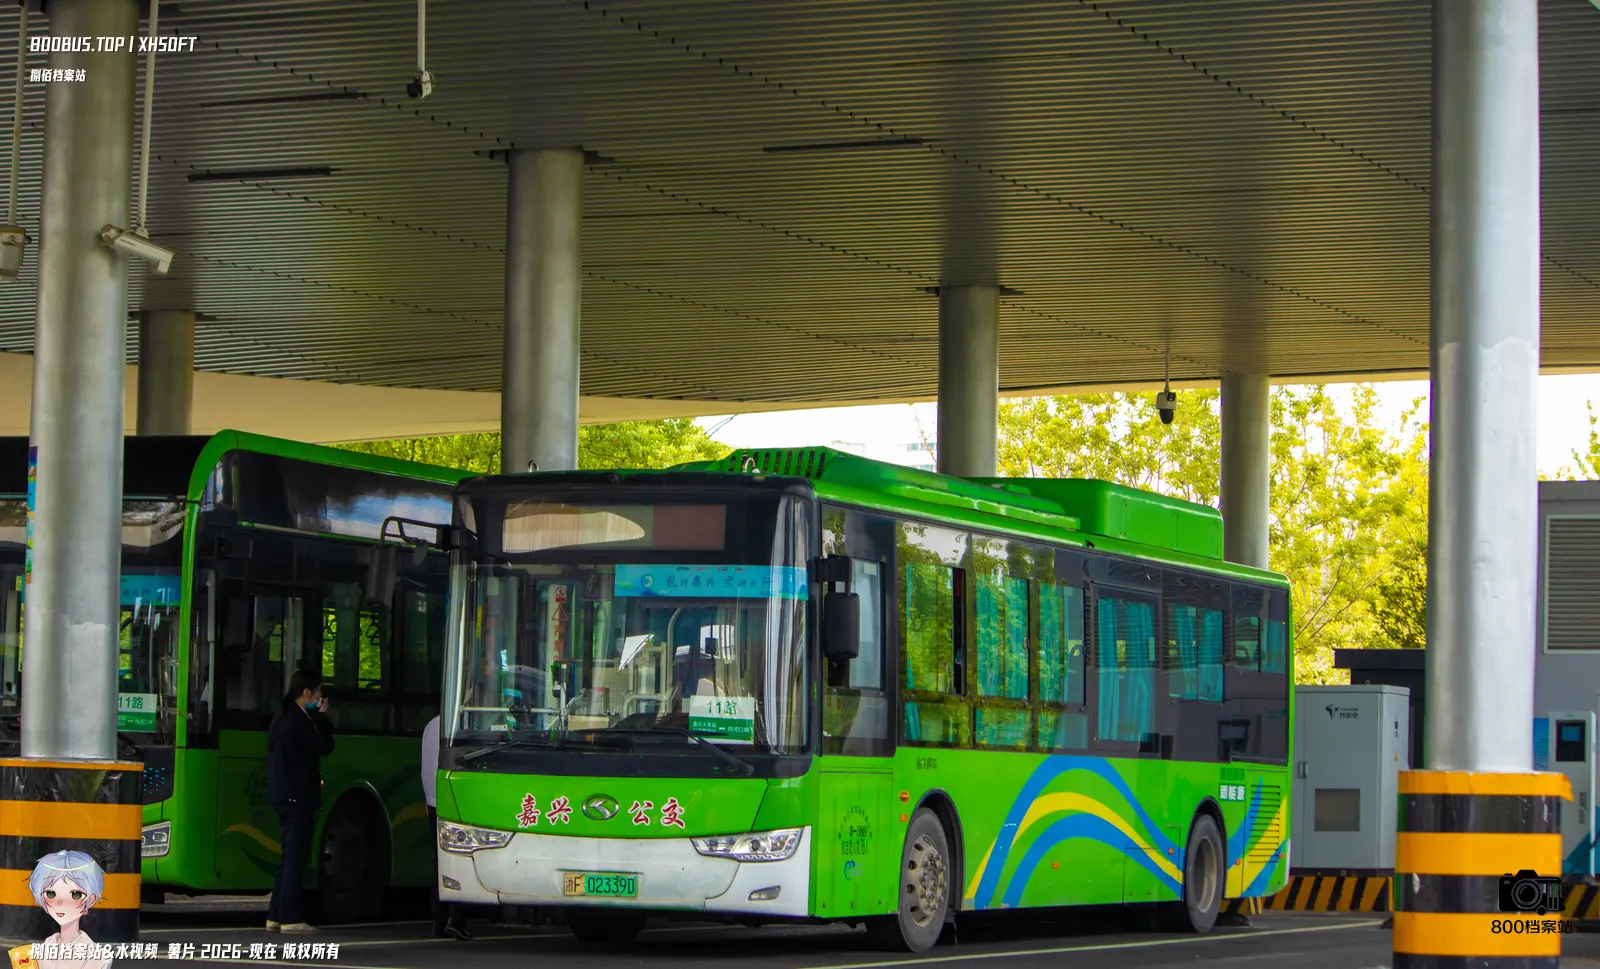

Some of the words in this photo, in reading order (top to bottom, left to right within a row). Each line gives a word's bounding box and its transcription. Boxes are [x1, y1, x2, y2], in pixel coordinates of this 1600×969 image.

[707, 700, 737, 715] 11路
[516, 793, 573, 828] 嘉兴
[628, 796, 686, 829] 公交
[587, 876, 635, 894] 02339D
